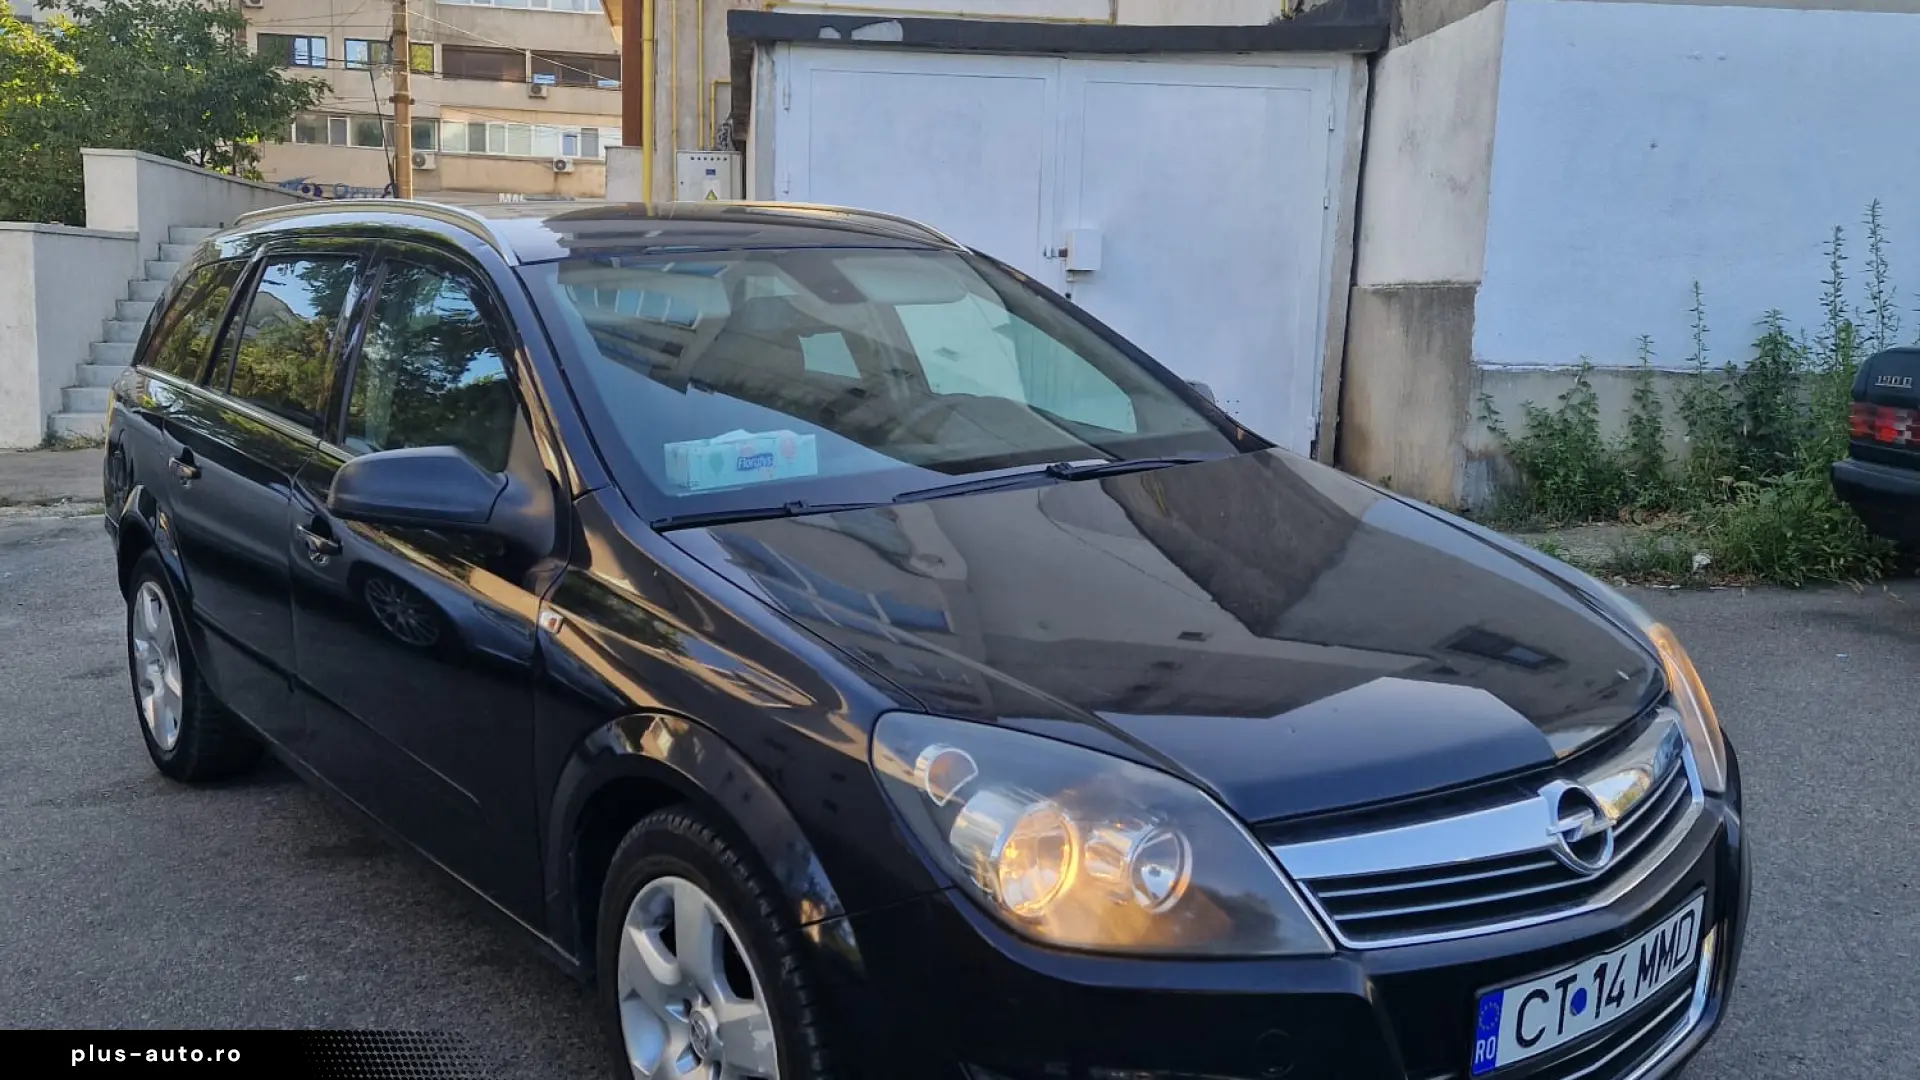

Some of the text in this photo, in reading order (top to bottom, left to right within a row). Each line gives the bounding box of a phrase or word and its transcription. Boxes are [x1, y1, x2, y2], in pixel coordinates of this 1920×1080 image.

[1515, 908, 1696, 1049] CT 14 MMD
[1474, 1036, 1496, 1065] RO
